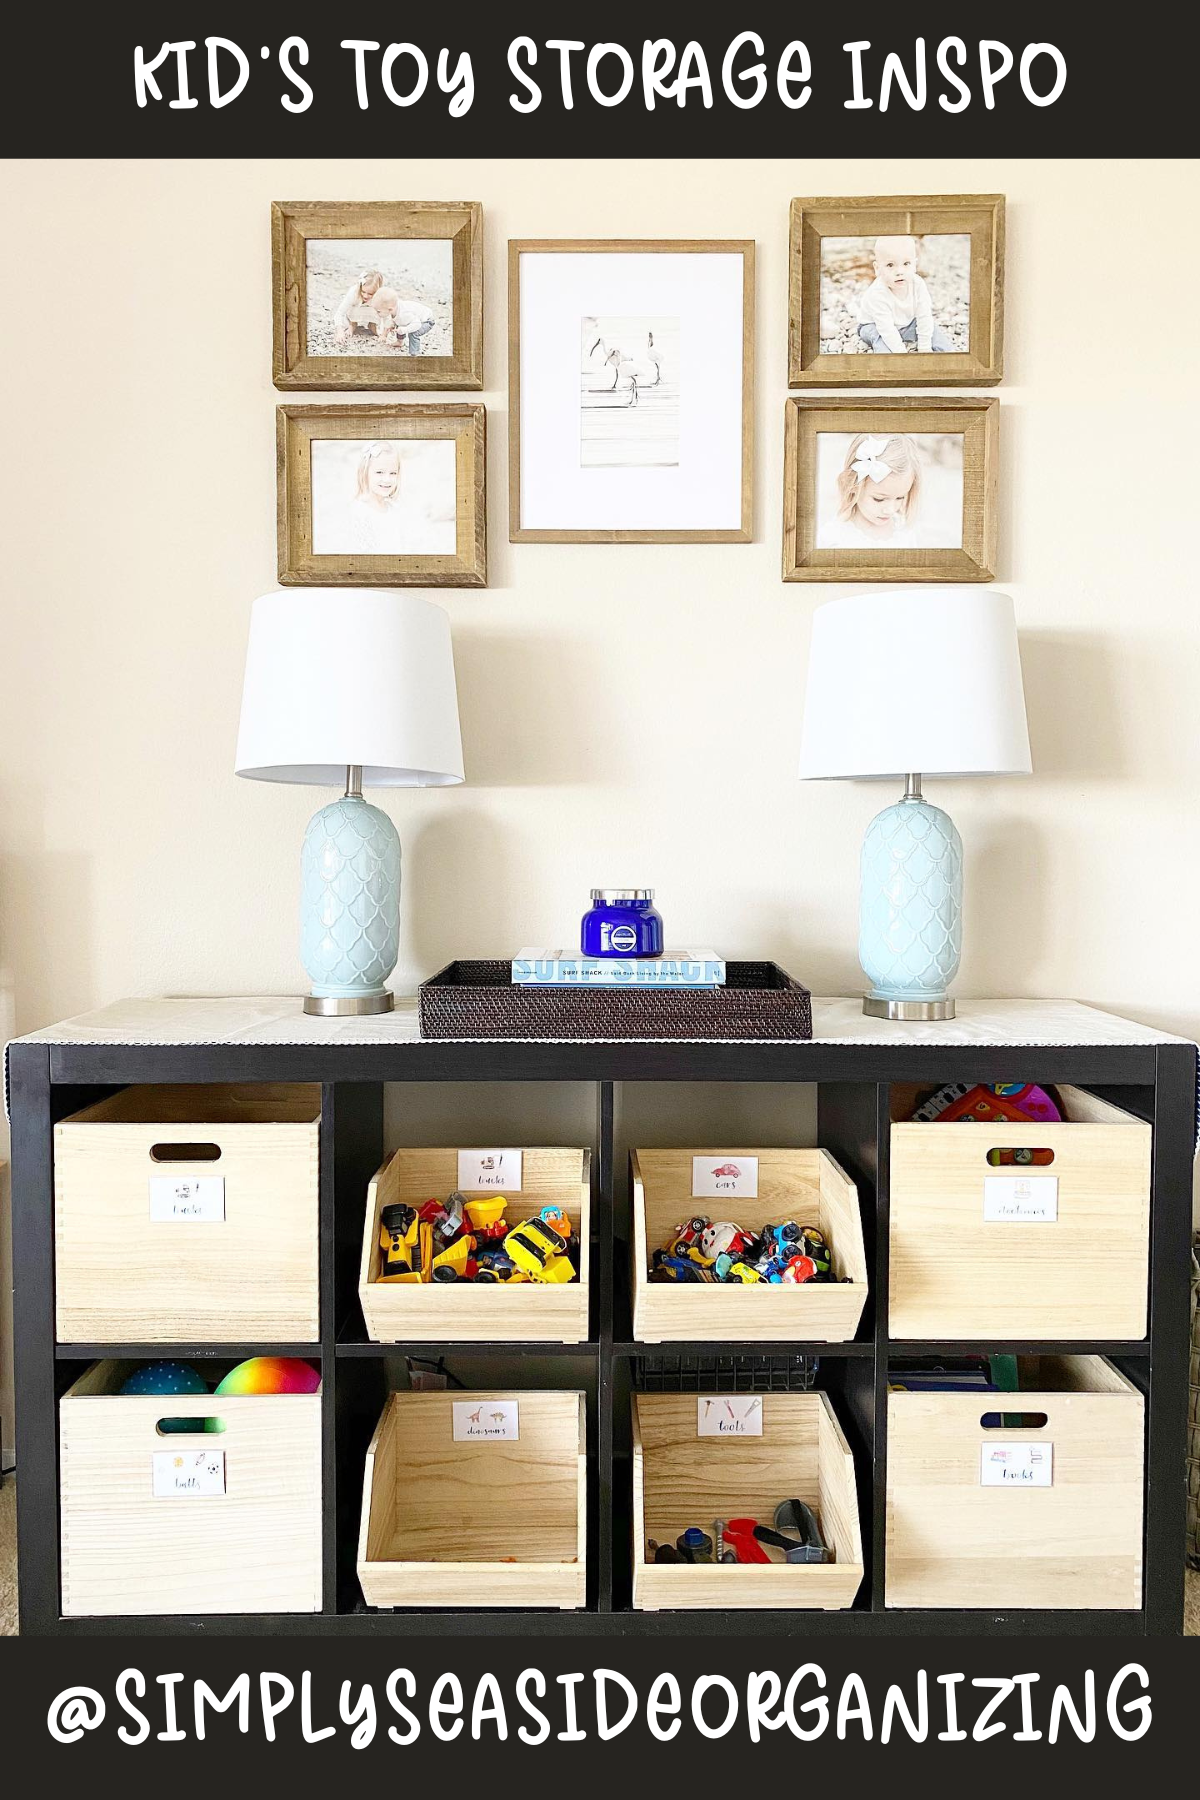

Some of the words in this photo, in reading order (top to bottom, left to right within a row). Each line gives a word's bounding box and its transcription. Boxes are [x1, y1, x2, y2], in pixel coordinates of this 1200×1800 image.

[715, 1181, 737, 1190] cars
[717, 1419, 747, 1432] tools
[466, 1426, 507, 1436] dinosaurs
